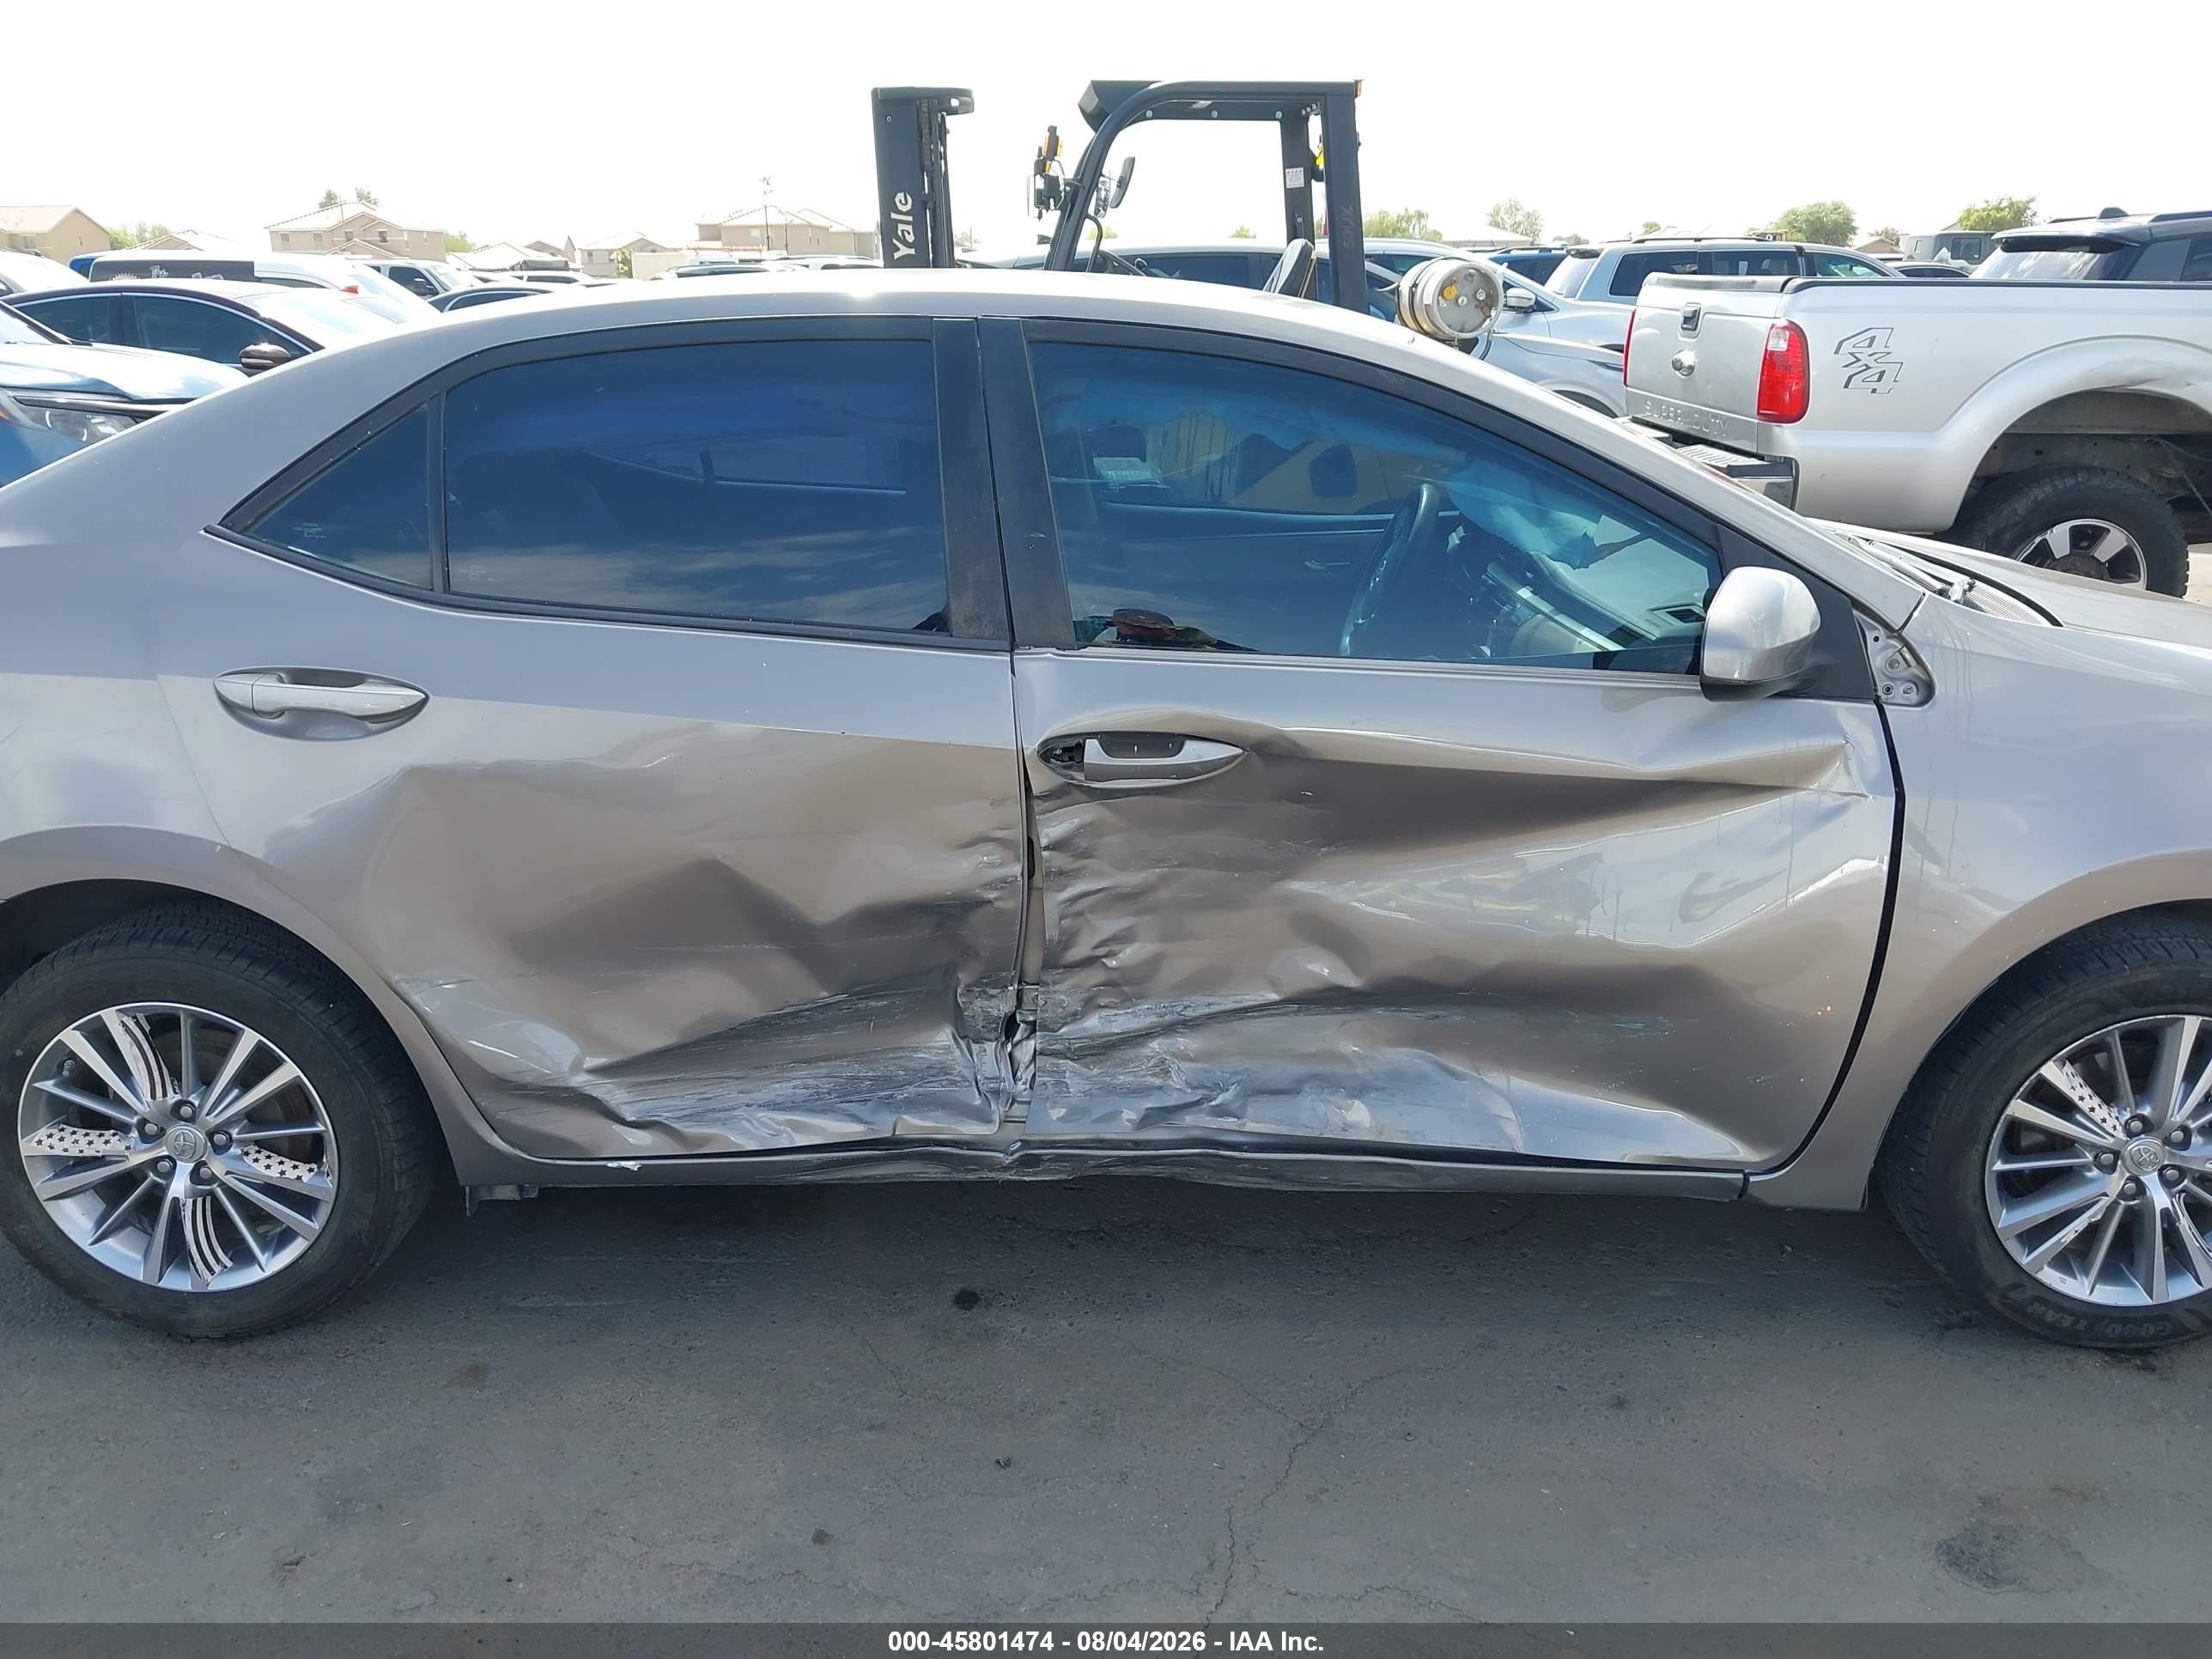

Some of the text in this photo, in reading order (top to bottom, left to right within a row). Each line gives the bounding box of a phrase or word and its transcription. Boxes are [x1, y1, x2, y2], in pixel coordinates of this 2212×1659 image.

[890, 191, 915, 260] Yale
[1644, 398, 1729, 438] SUPER DUTY
